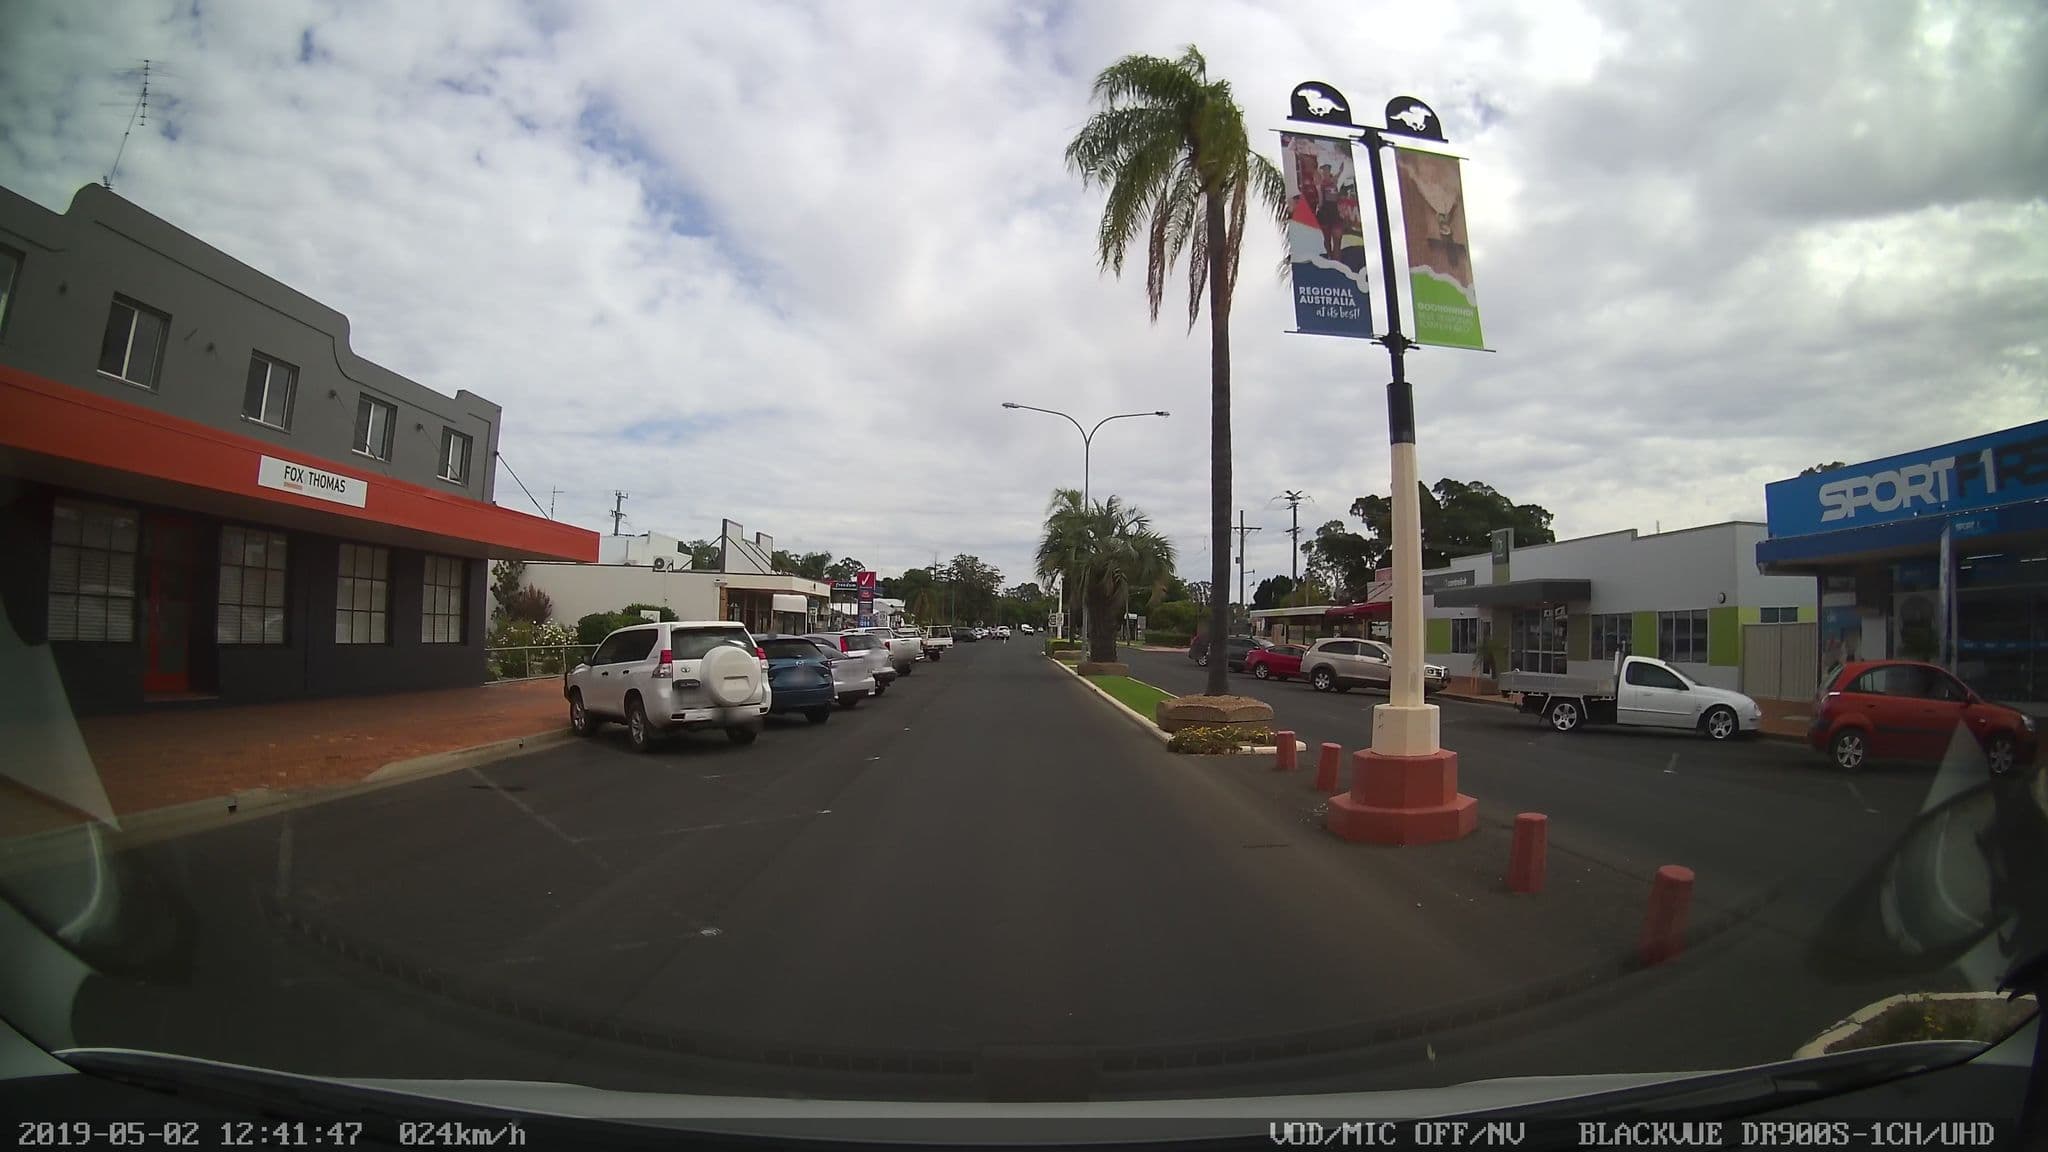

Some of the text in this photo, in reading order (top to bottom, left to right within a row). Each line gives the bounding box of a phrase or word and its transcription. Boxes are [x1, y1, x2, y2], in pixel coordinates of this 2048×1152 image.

[1299, 286, 1353, 298] REGIONAL
[1299, 295, 1356, 307] AUSTRALIA
[1316, 306, 1326, 318] at
[1327, 306, 1339, 319] its
[284, 465, 304, 483] FOX
[308, 471, 346, 493] THOMAS
